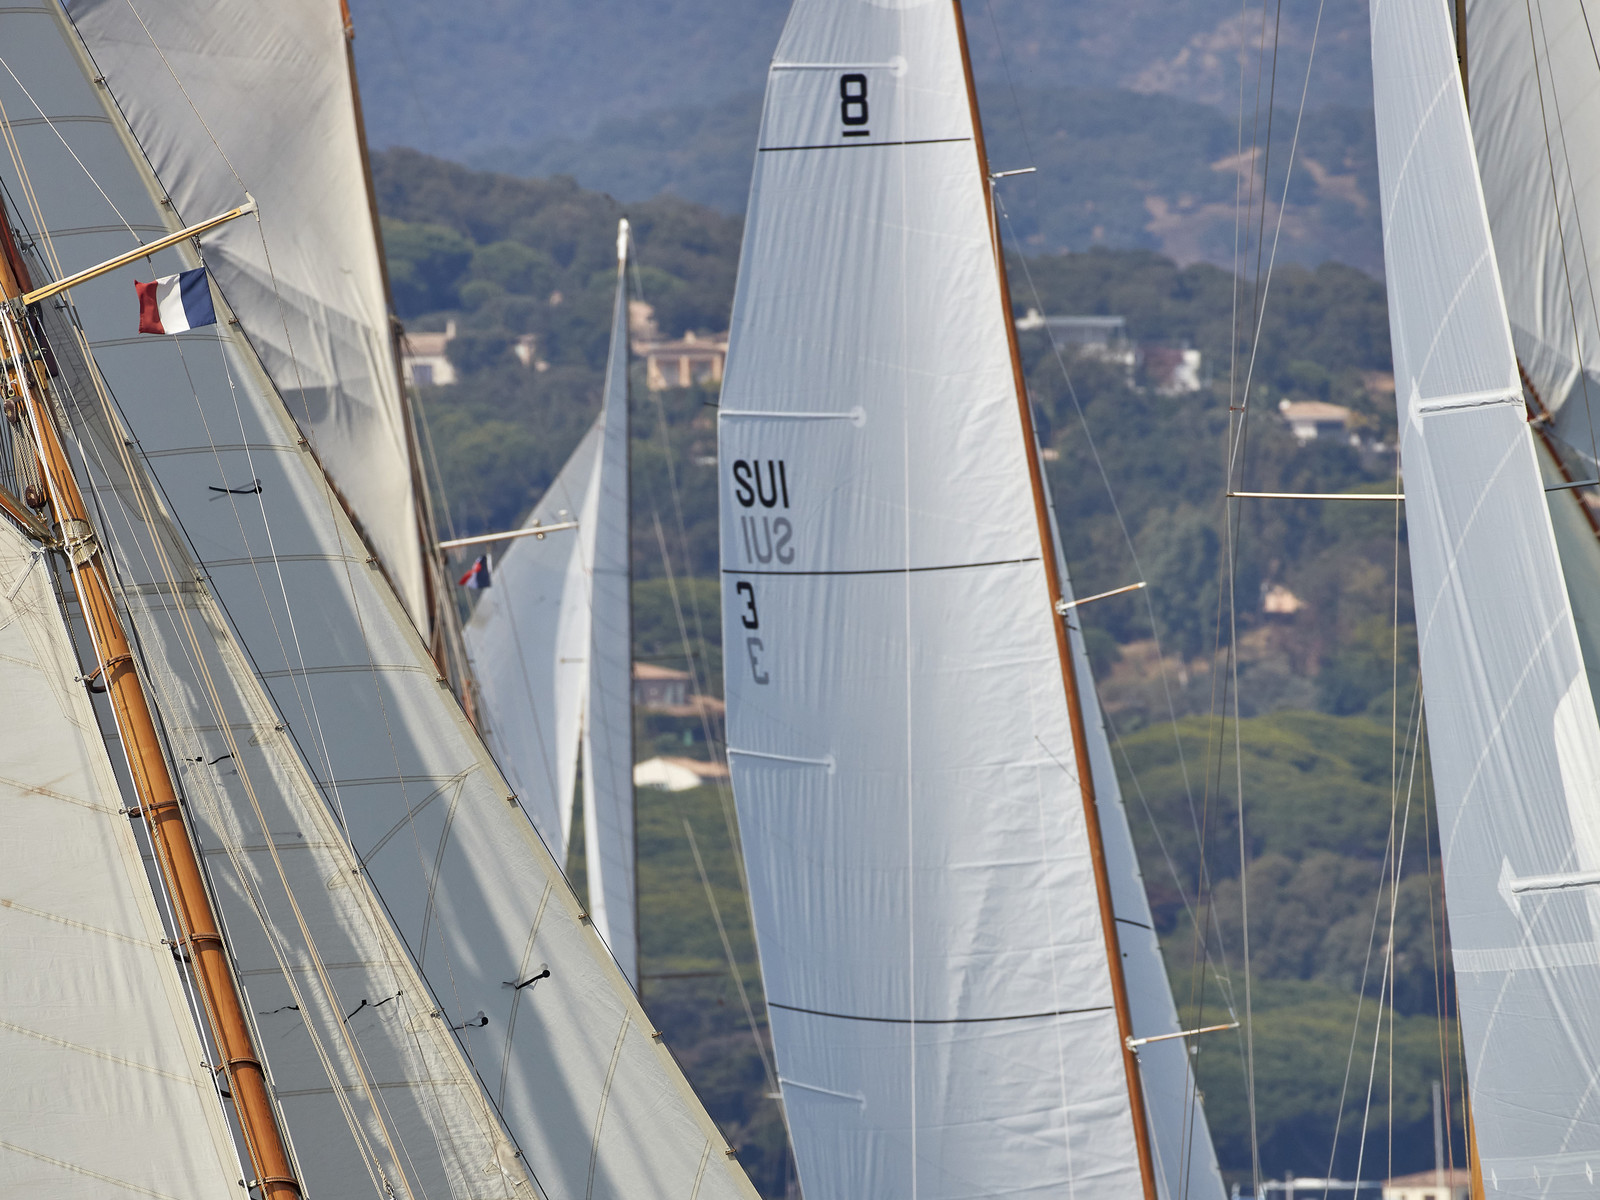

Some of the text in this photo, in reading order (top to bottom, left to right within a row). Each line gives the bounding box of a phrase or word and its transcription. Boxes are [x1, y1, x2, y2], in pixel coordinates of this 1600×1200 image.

[840, 73, 870, 126] 8
[732, 459, 790, 508] SUI
[736, 581, 759, 630] 3
